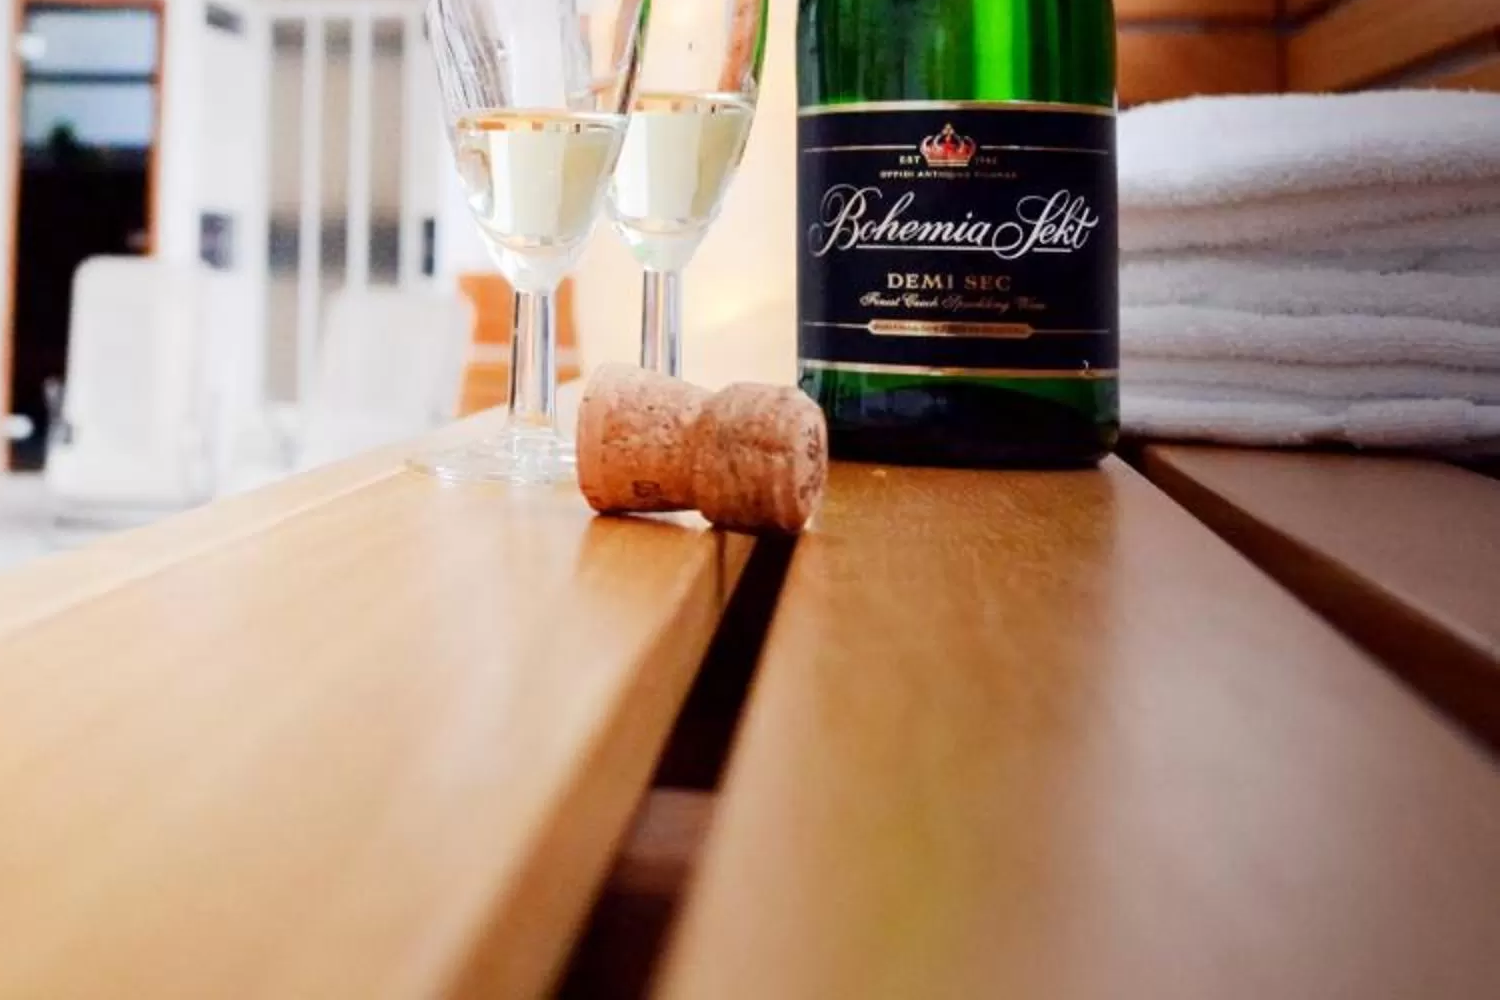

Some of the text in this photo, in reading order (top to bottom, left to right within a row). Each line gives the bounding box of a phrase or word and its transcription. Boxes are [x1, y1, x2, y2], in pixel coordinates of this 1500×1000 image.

[808, 183, 1099, 260] Bohemia Sekt
[887, 272, 1012, 292] DEMI SEC
